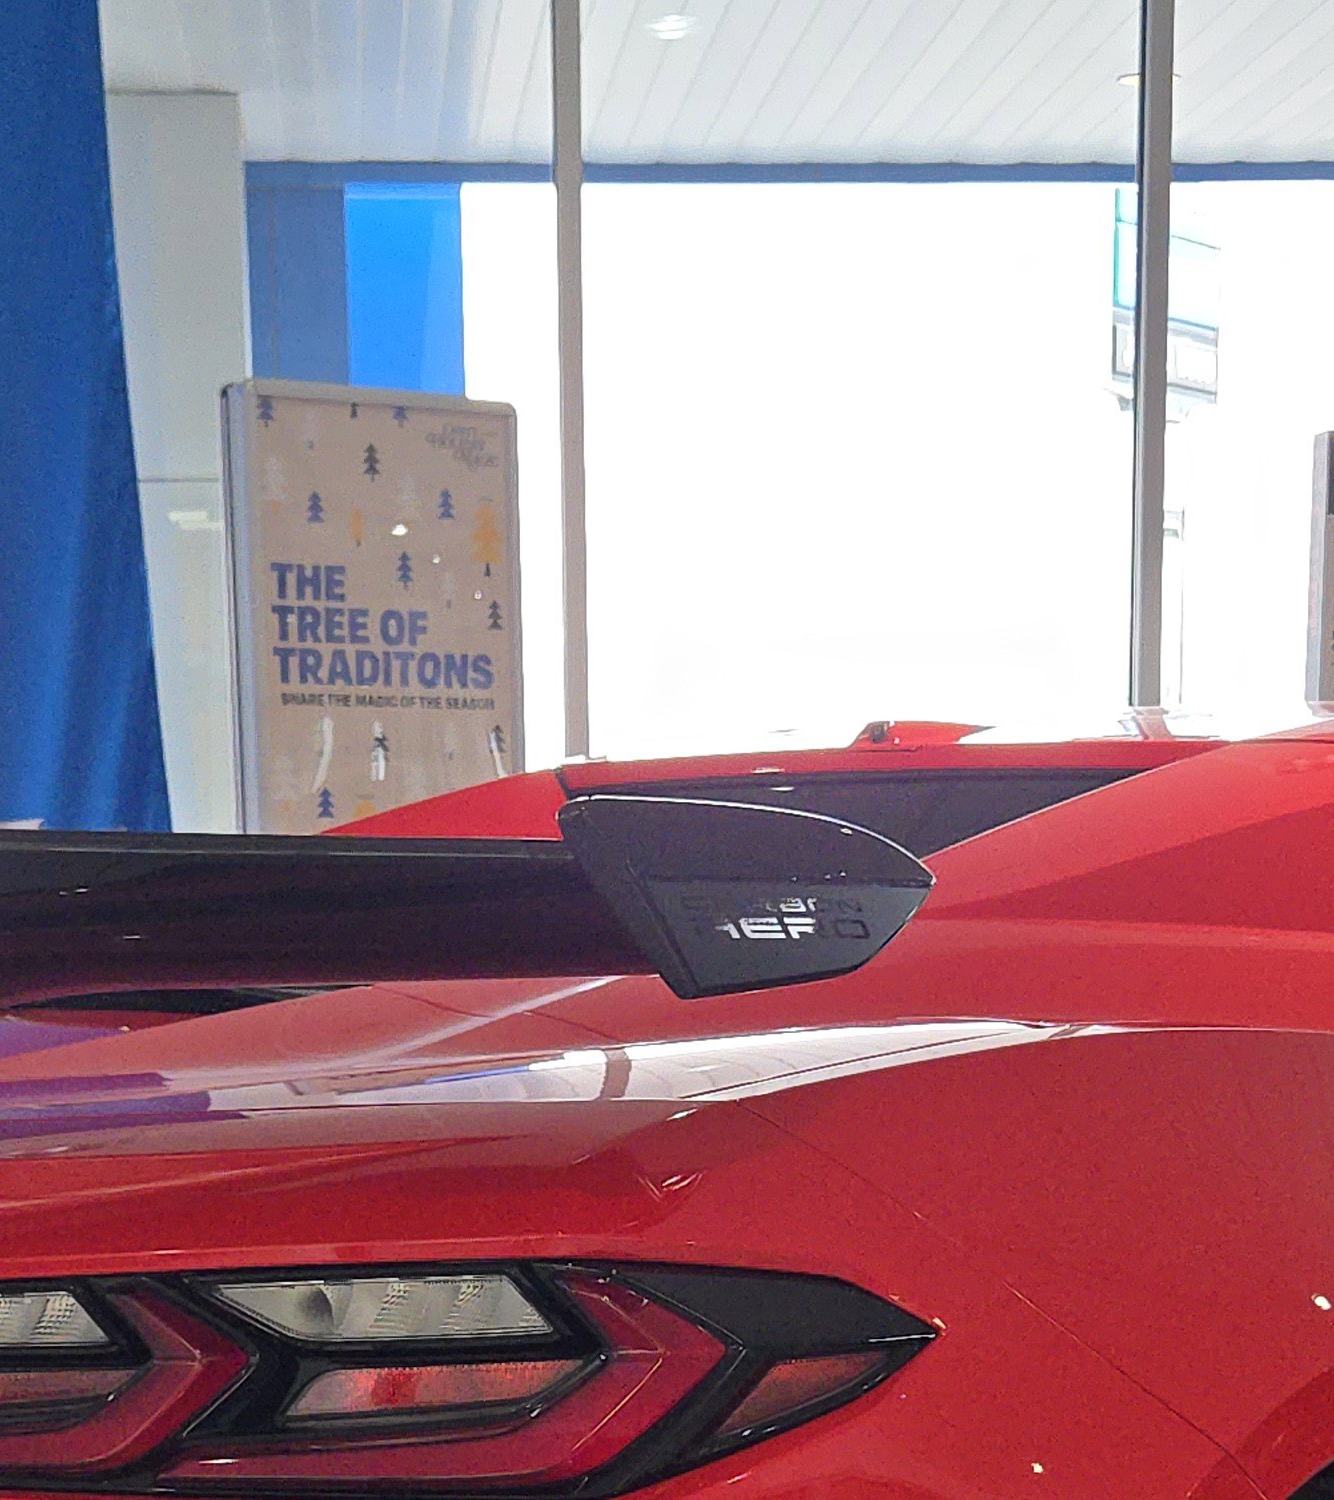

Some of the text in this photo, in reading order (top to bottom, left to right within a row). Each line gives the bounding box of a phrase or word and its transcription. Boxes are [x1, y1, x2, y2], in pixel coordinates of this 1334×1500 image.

[271, 562, 346, 602] THE
[272, 605, 429, 646] TREE OF
[273, 646, 495, 690] TRADITONS
[328, 693, 351, 708] THE
[419, 695, 443, 709] THE
